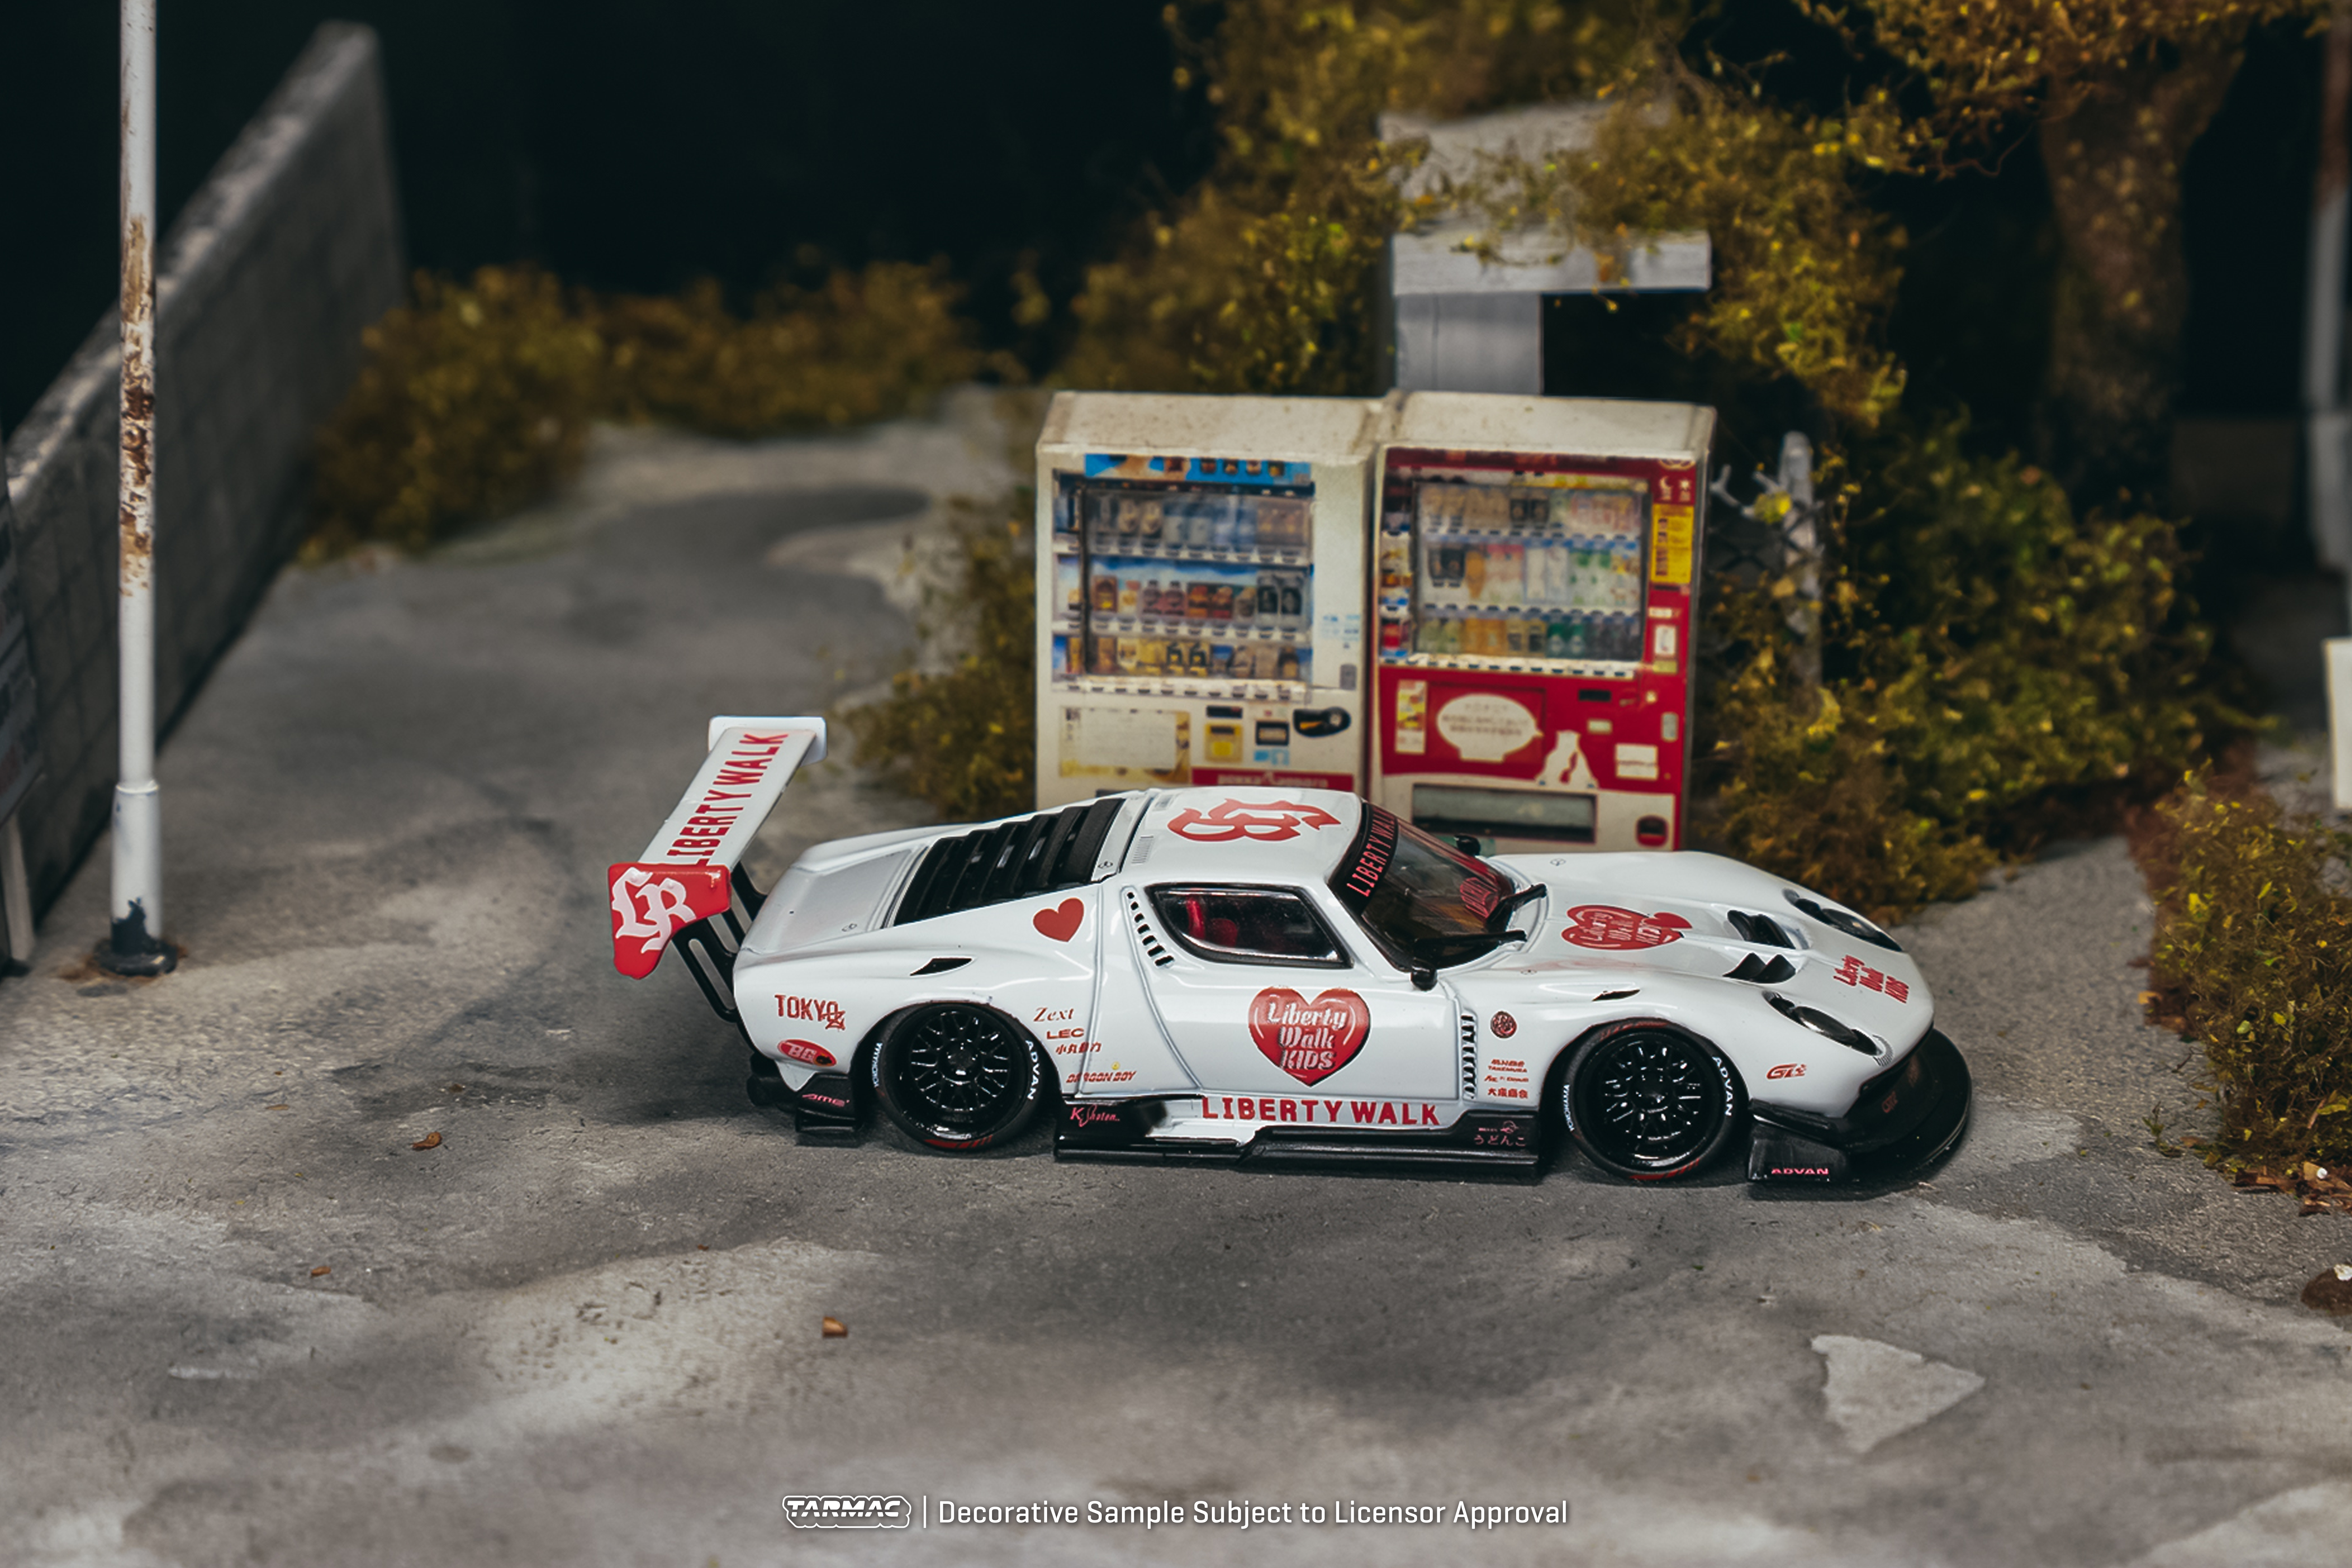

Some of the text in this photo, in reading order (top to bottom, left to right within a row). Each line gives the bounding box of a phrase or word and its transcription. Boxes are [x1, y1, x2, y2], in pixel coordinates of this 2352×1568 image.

[713, 734, 788, 785] WALK
[1347, 834, 1391, 897] LIBERTY
[1047, 1028, 1084, 1040] LEC
[1268, 1002, 1347, 1030] Liberty
[1280, 1027, 1335, 1049] Walk
[872, 1043, 883, 1087] YOKOHAMA
[1025, 1040, 1040, 1100] ADVAN
[1281, 1050, 1337, 1070] KIDS
[1712, 1056, 1732, 1116] ADVAN
[1202, 1097, 1439, 1125] LIBERTY WALK
